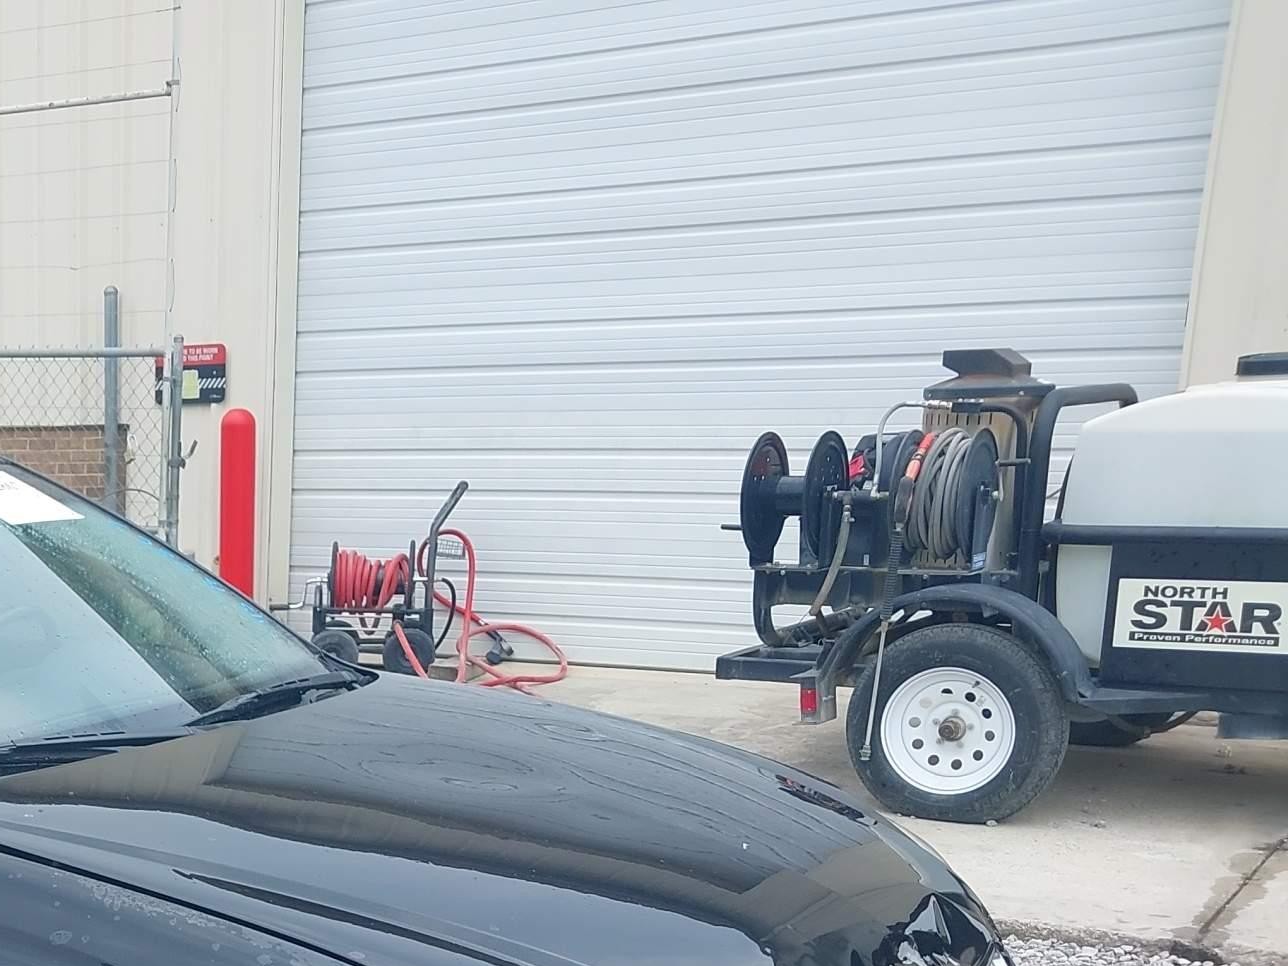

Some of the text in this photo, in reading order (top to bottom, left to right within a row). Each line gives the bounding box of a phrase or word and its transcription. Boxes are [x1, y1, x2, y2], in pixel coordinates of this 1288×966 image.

[1143, 585, 1229, 600] NORTH
[1130, 598, 1283, 636] STAR
[1134, 632, 1275, 646] Proven Performance
